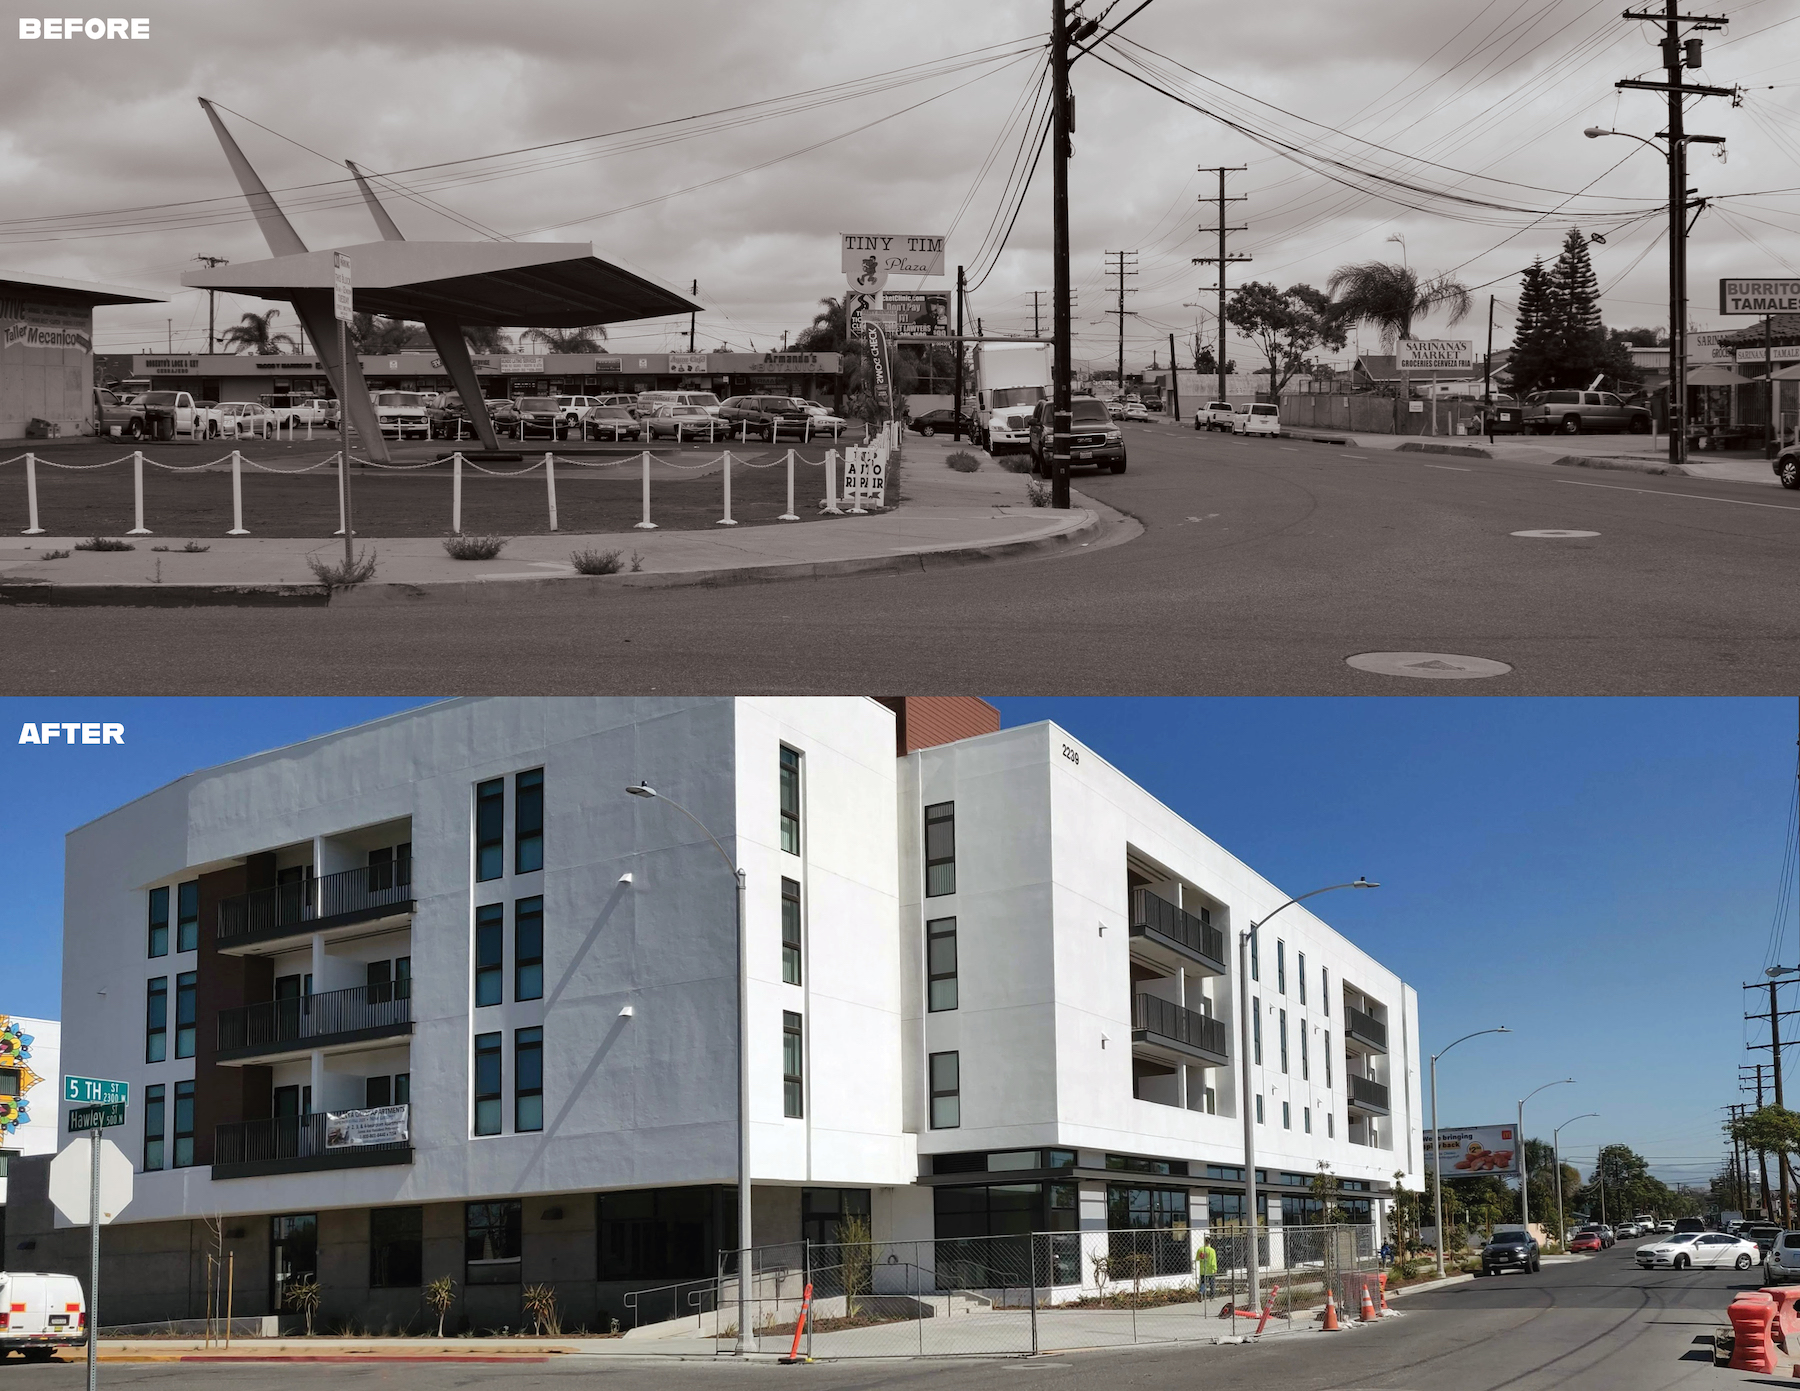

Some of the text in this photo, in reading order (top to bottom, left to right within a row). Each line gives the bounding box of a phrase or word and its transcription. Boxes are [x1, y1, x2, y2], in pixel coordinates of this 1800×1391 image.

[845, 236, 943, 252] TINY TIM
[884, 257, 927, 271] Plaza
[908, 303, 921, 312] Pay
[903, 324, 931, 332] LAWYERS
[4, 325, 76, 346] Taller Mecanico
[1406, 342, 1467, 351] SARINANA'S
[764, 352, 817, 363] Armando's
[1412, 351, 1461, 359] MARKET
[146, 358, 199, 368] ROBERTO'S LOCK & KEY
[757, 363, 824, 372] BOTANICA
[1402, 360, 1471, 368] GROCERIES CERVEZA FRIA
[1062, 743, 1080, 765] 2239
[70, 1079, 120, 1101] 5 TH ST
[103, 1092, 119, 1103] 2300
[70, 1104, 119, 1129] Hawley ST
[106, 1114, 123, 1126] 500 N
[1442, 1133, 1473, 1141] bringing
[1442, 1141, 1460, 1149] back
